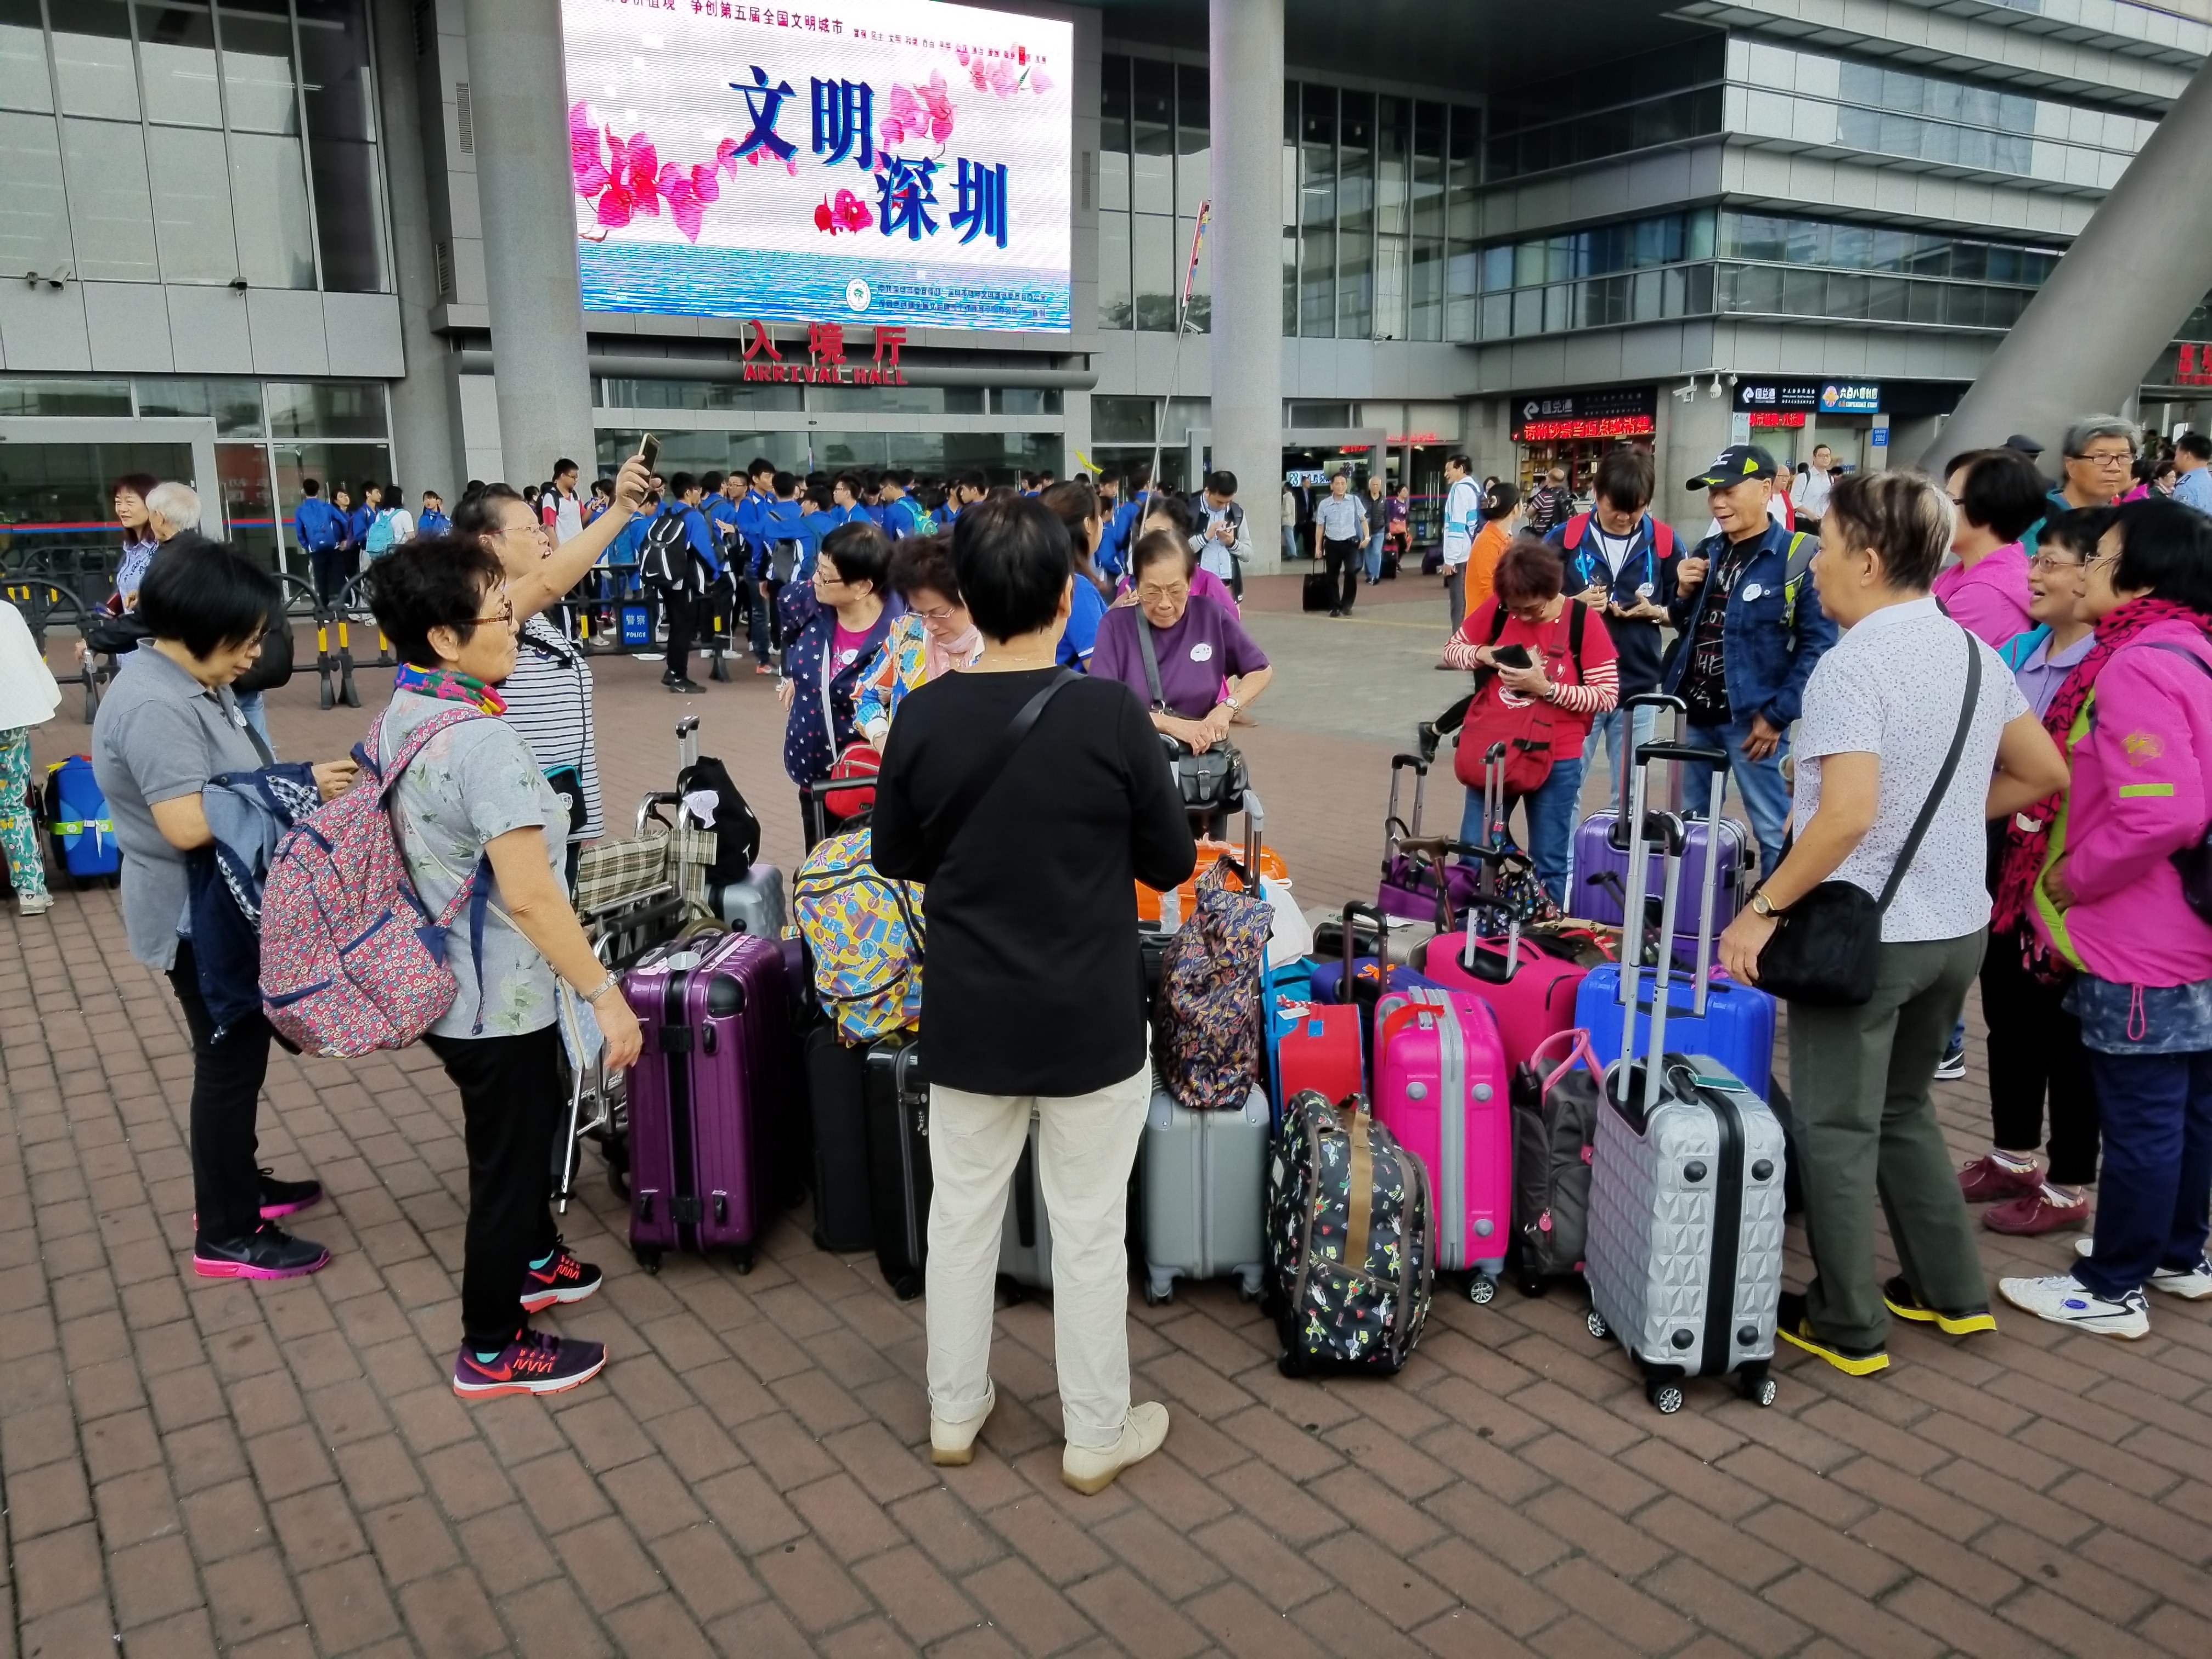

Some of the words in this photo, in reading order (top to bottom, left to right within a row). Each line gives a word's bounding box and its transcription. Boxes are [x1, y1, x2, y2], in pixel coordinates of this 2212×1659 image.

[729, 64, 875, 171] 文明
[874, 151, 1008, 249] 深圳
[743, 319, 907, 366] 入境厅
[744, 364, 845, 383] ARRIVAL
[853, 367, 909, 385] HALL
[625, 614, 646, 626] 警察
